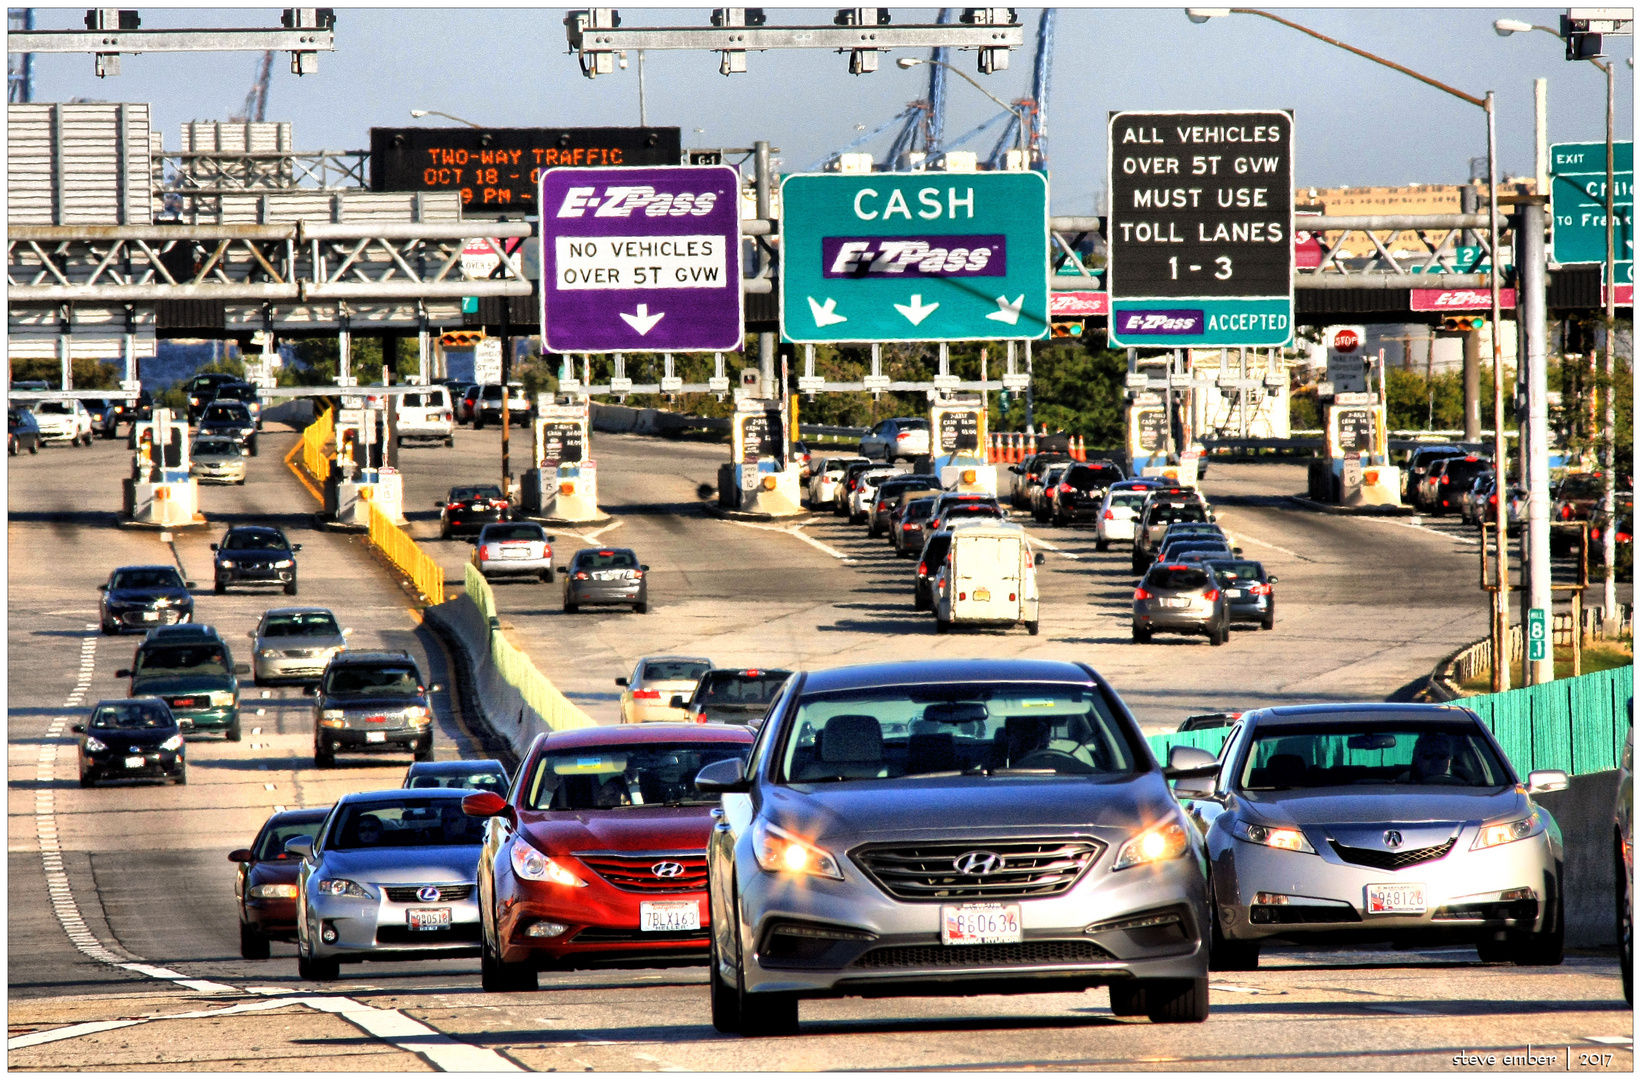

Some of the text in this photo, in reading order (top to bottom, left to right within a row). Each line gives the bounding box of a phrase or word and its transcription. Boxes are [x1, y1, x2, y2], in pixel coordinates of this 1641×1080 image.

[1122, 126, 1280, 144] ALL VEHICLES
[428, 148, 624, 165] TWO-WAY TRAFFIC
[1123, 156, 1279, 174] OVER 5T GVW
[1557, 153, 1584, 164] EXIT
[424, 168, 463, 185] OCT
[476, 168, 498, 185] 18
[484, 188, 511, 204] PM
[1586, 181, 1633, 197] Chil
[557, 185, 717, 218] E-ZPass
[854, 187, 974, 220] CASH
[1133, 188, 1268, 208] MUST USE
[1557, 215, 1572, 226] TO
[1120, 223, 1183, 242] TOLL
[1199, 222, 1283, 242] LANES
[570, 241, 713, 258] NO VEHICLES
[831, 240, 992, 273] E-ZPass
[1463, 248, 1473, 262] 2
[564, 266, 719, 285] OVER 5T GVW
[1169, 256, 1177, 280] 1
[1214, 256, 1233, 280] 3
[462, 297, 471, 310] 7
[1126, 314, 1287, 330] E-ZPass ACCEPTED
[1335, 336, 1357, 347] STOP
[1531, 621, 1543, 639] 8
[645, 912, 695, 927] 7BLX163
